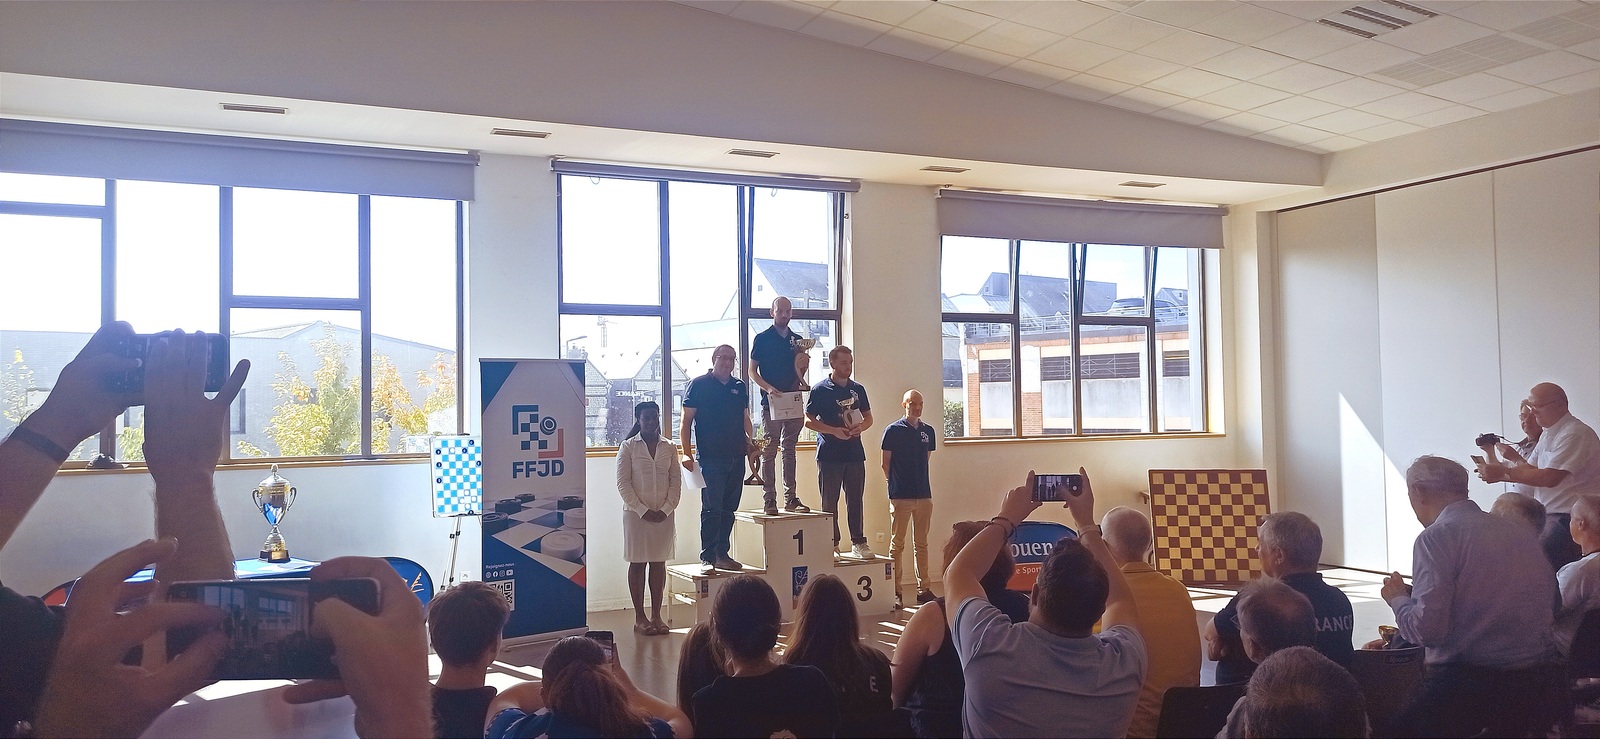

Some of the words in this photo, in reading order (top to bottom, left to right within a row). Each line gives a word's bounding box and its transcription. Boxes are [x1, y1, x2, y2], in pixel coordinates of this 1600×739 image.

[512, 460, 565, 479] FFJD
[793, 530, 804, 555] 1
[1010, 541, 1053, 558] ouen
[856, 575, 873, 602] 3
